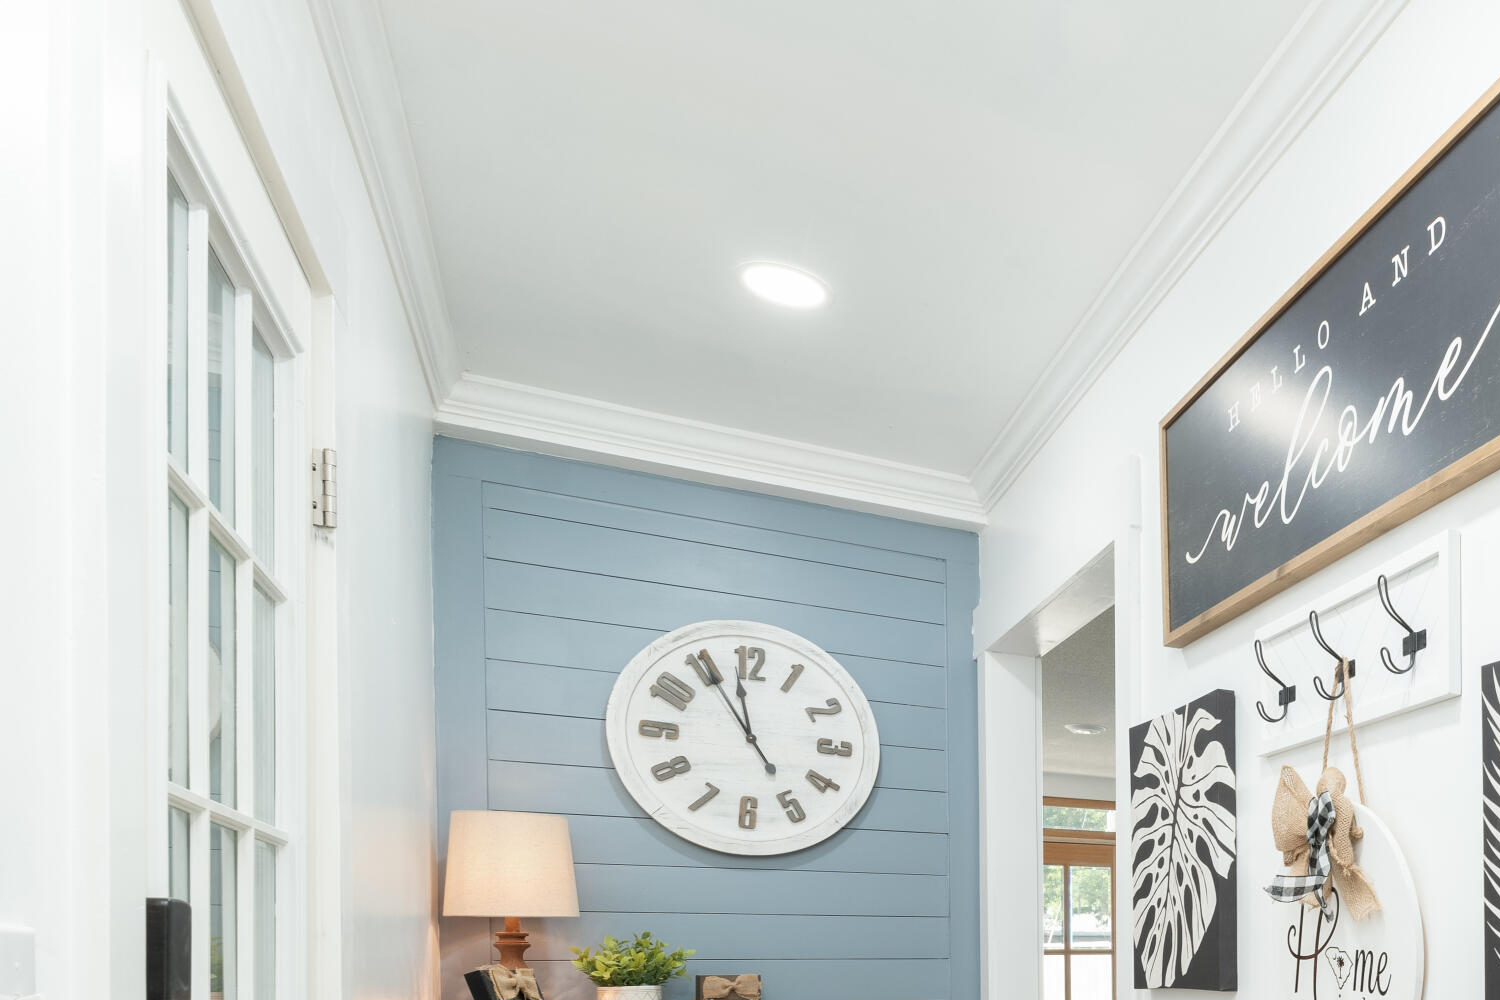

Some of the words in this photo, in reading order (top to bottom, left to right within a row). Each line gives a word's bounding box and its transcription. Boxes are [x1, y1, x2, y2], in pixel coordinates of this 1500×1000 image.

[1227, 320, 1330, 433] HELLO
[1358, 215, 1446, 317] AND
[684, 648, 724, 687] 11
[734, 645, 766, 682] 12
[780, 663, 805, 693] 1
[649, 671, 696, 712] 10
[804, 697, 842, 723] 2
[638, 719, 680, 740] 9
[816, 737, 853, 757] 3
[650, 755, 692, 782] 8
[804, 769, 841, 793] 4
[687, 782, 721, 812] 7
[776, 789, 807, 824] 5
[738, 795, 759, 830] 6
